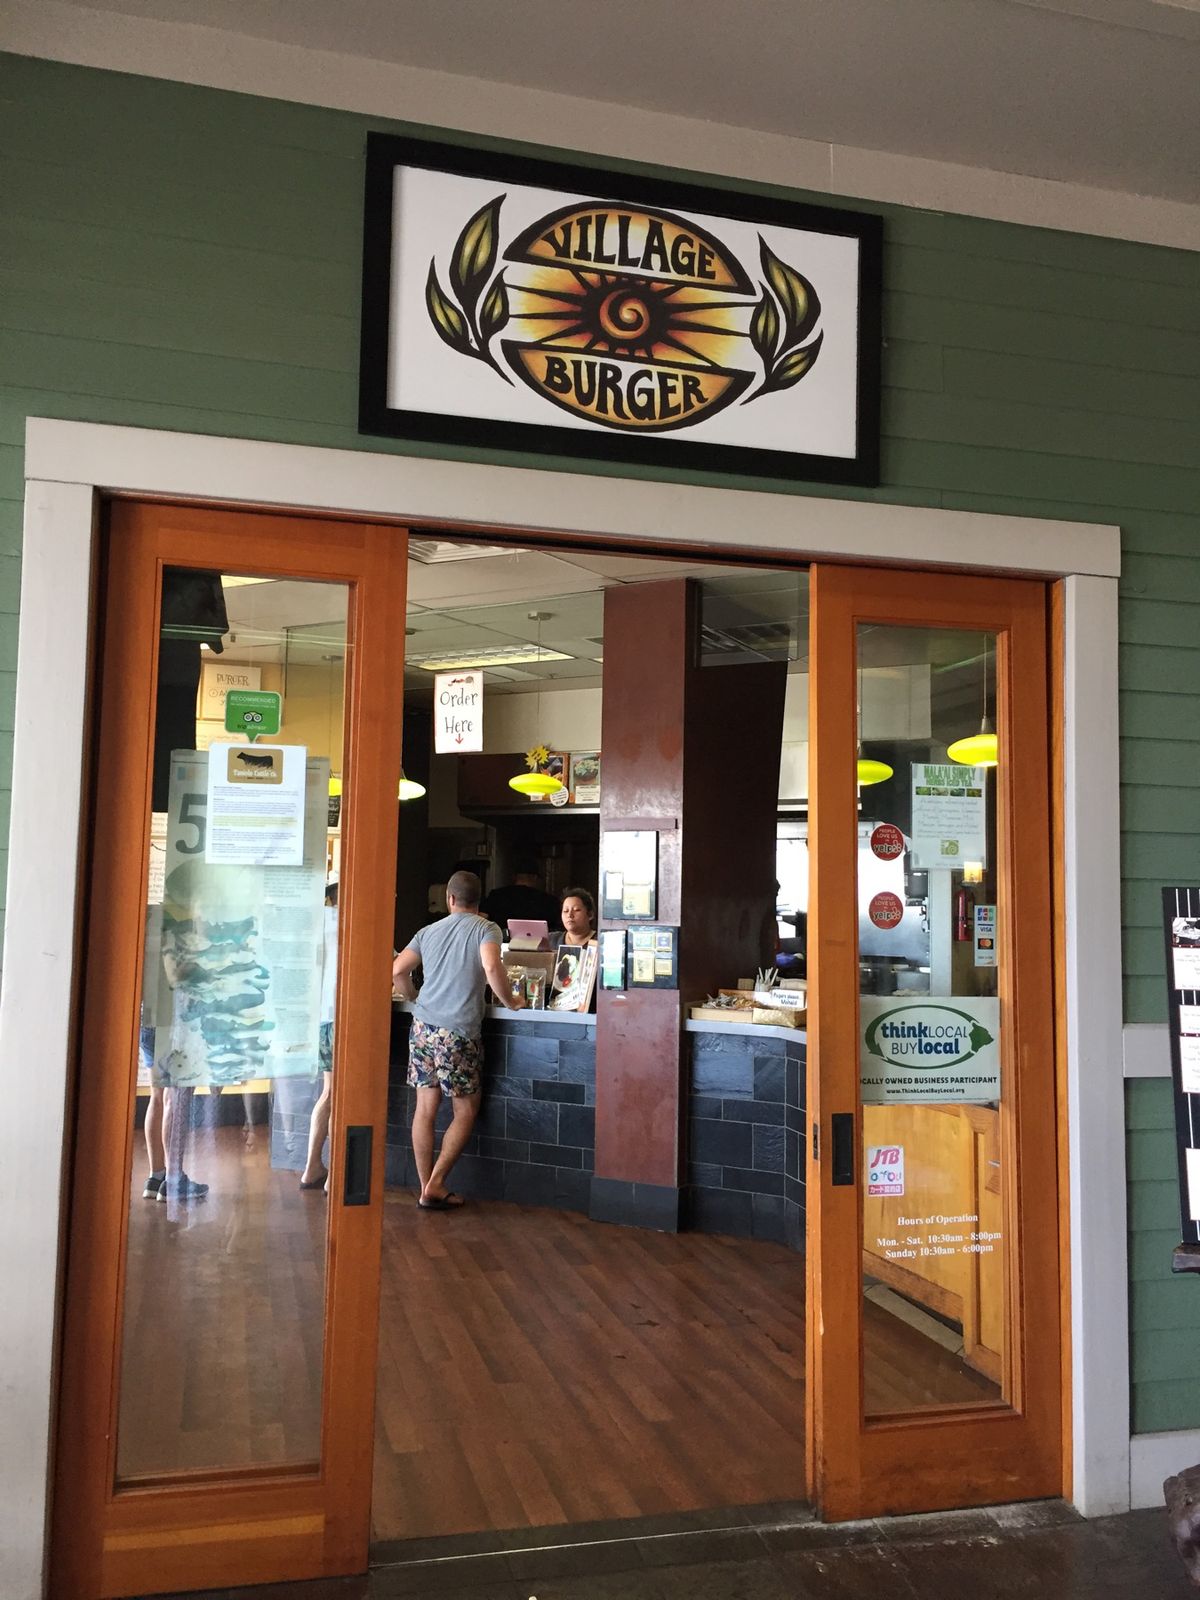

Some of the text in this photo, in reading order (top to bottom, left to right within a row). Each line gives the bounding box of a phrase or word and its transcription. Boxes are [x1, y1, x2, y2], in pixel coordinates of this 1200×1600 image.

[541, 213, 718, 279] VILLAGE
[542, 355, 709, 423] BURGER
[230, 695, 276, 704] RECOMMENDED
[439, 687, 479, 708] Order
[444, 716, 474, 734] Here
[952, 766, 976, 780] SIMPLY
[961, 779, 973, 788] TEA
[175, 793, 208, 856] 5
[874, 844, 893, 854] yelp
[873, 911, 892, 921] yelp
[977, 907, 994, 921] JCB
[885, 1077, 913, 1085] OWNED
[914, 1077, 949, 1085] BUSINESS
[950, 1076, 997, 1084] PARTICIPANT
[870, 1148, 900, 1169] JTB
[897, 1214, 978, 1226] Hours of Operation
[876, 1238, 900, 1247] Mon.
[907, 1236, 924, 1245] Sat.
[928, 1234, 963, 1243] 10:30am
[970, 1232, 1002, 1241] 8:00pm
[885, 1249, 917, 1259] Sunday
[920, 1247, 955, 1256] 10:30am
[963, 1244, 994, 1253] 6:00pm
